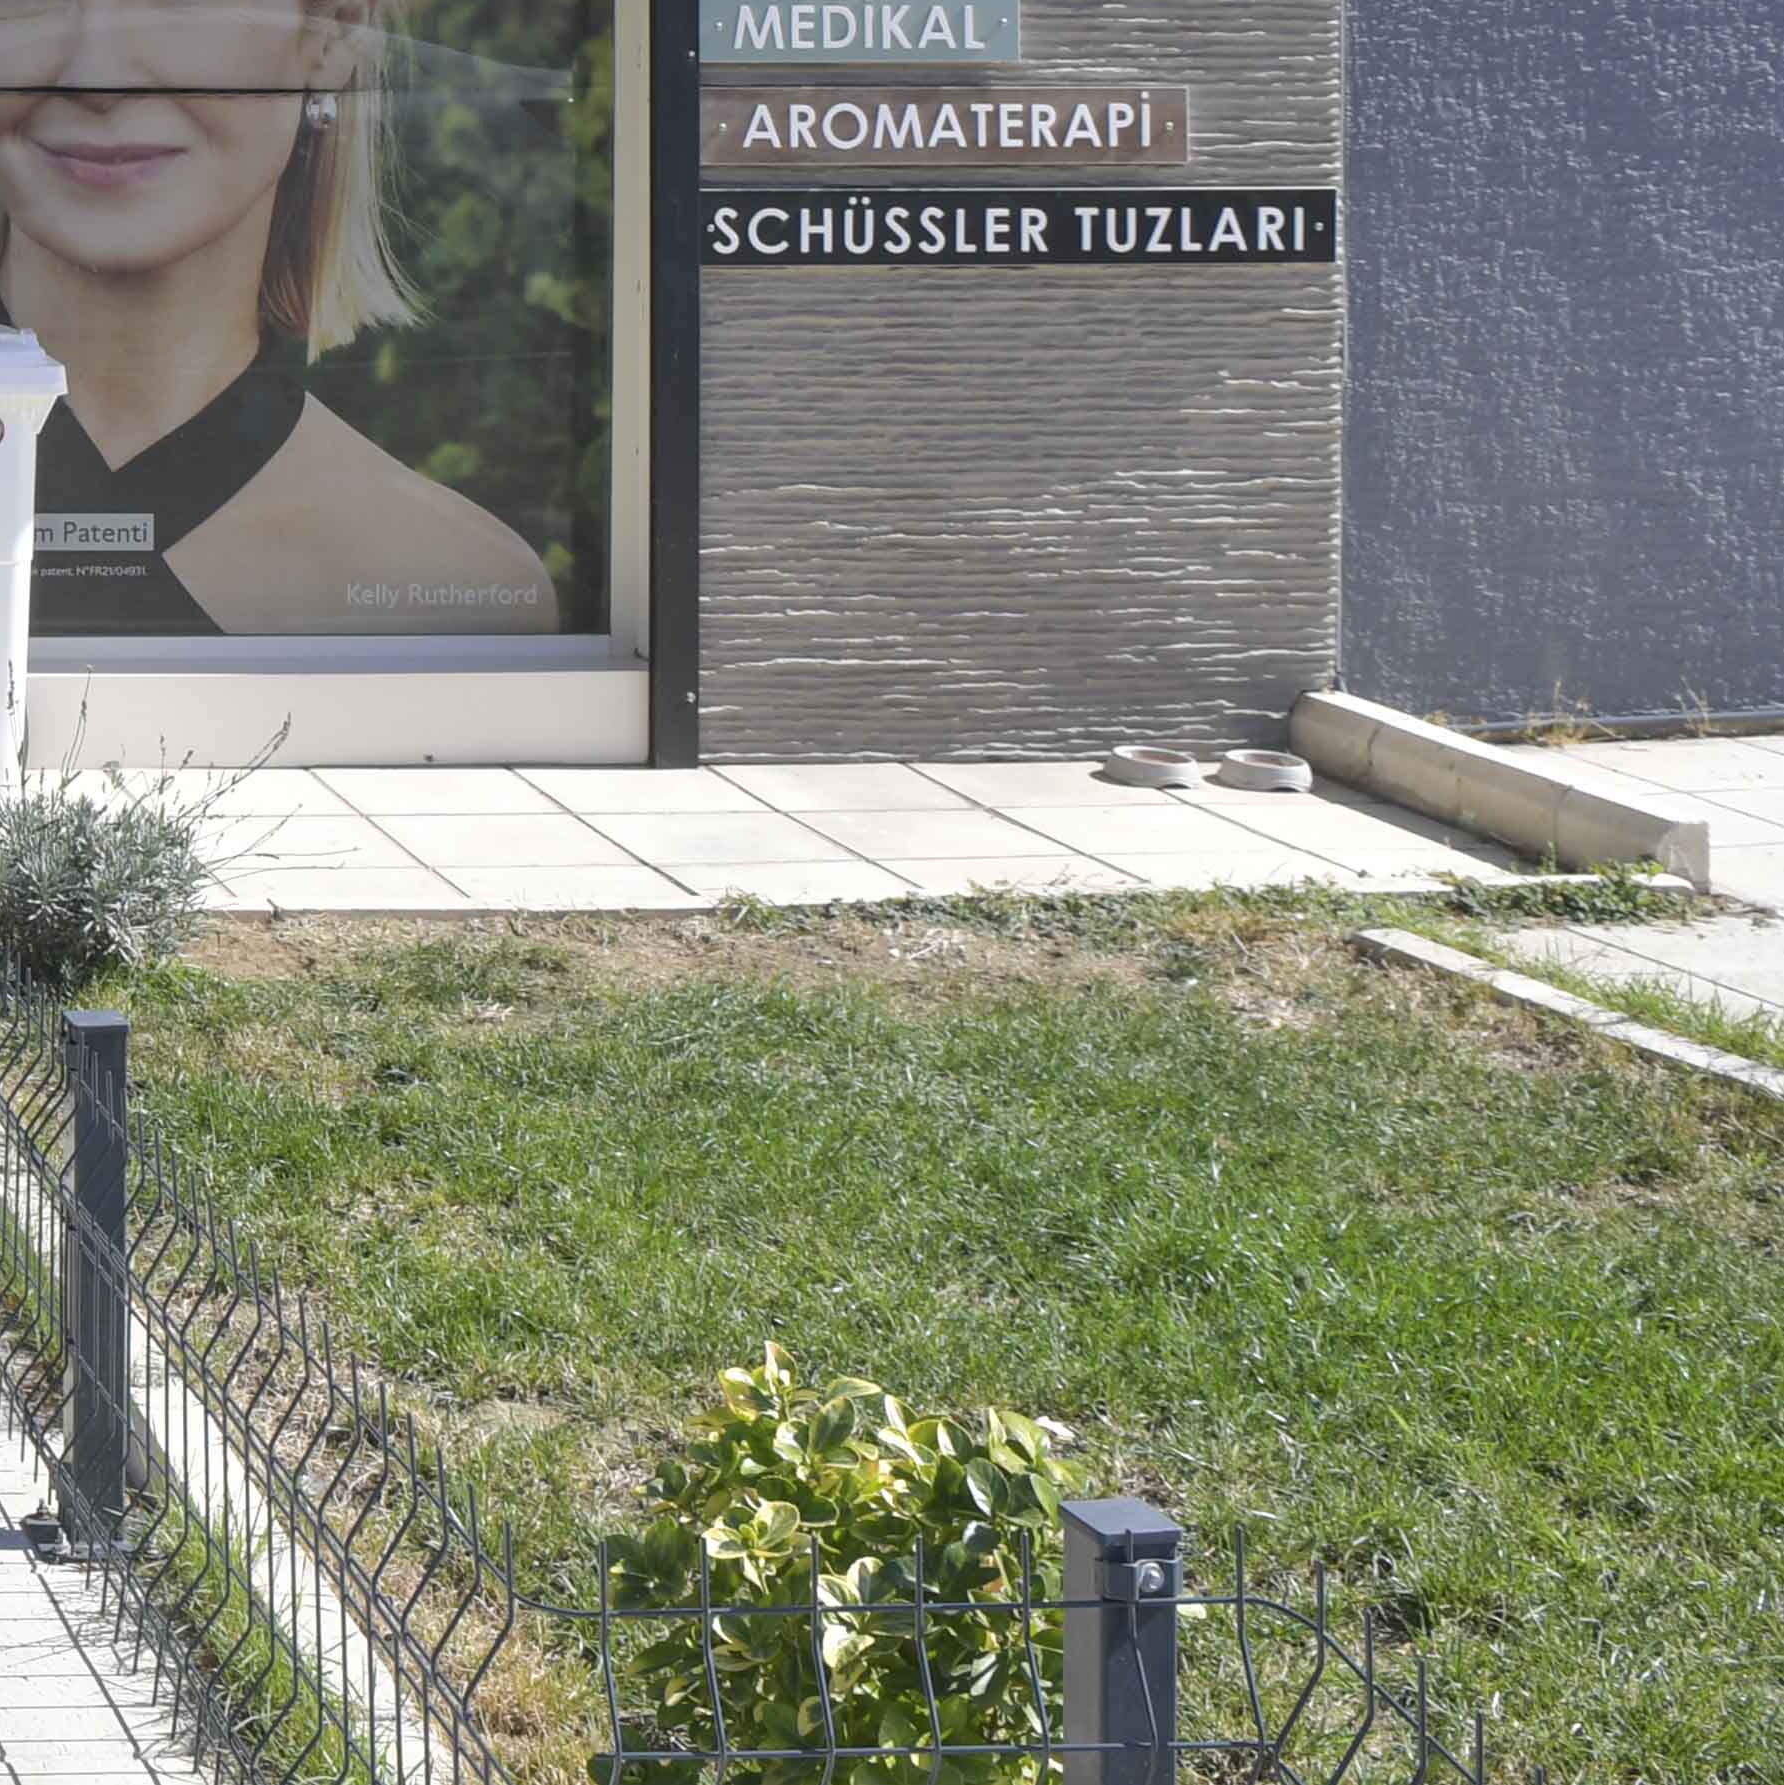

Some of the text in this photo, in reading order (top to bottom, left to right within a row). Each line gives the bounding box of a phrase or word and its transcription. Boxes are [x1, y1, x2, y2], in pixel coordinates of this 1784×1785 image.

[743, 91, 1152, 150] AROMATERAPİ
[711, 198, 1305, 254] SCHÜSSLER TUZLARI
[63, 521, 148, 543] Patenti
[346, 583, 538, 608] Kelly Rutherford
